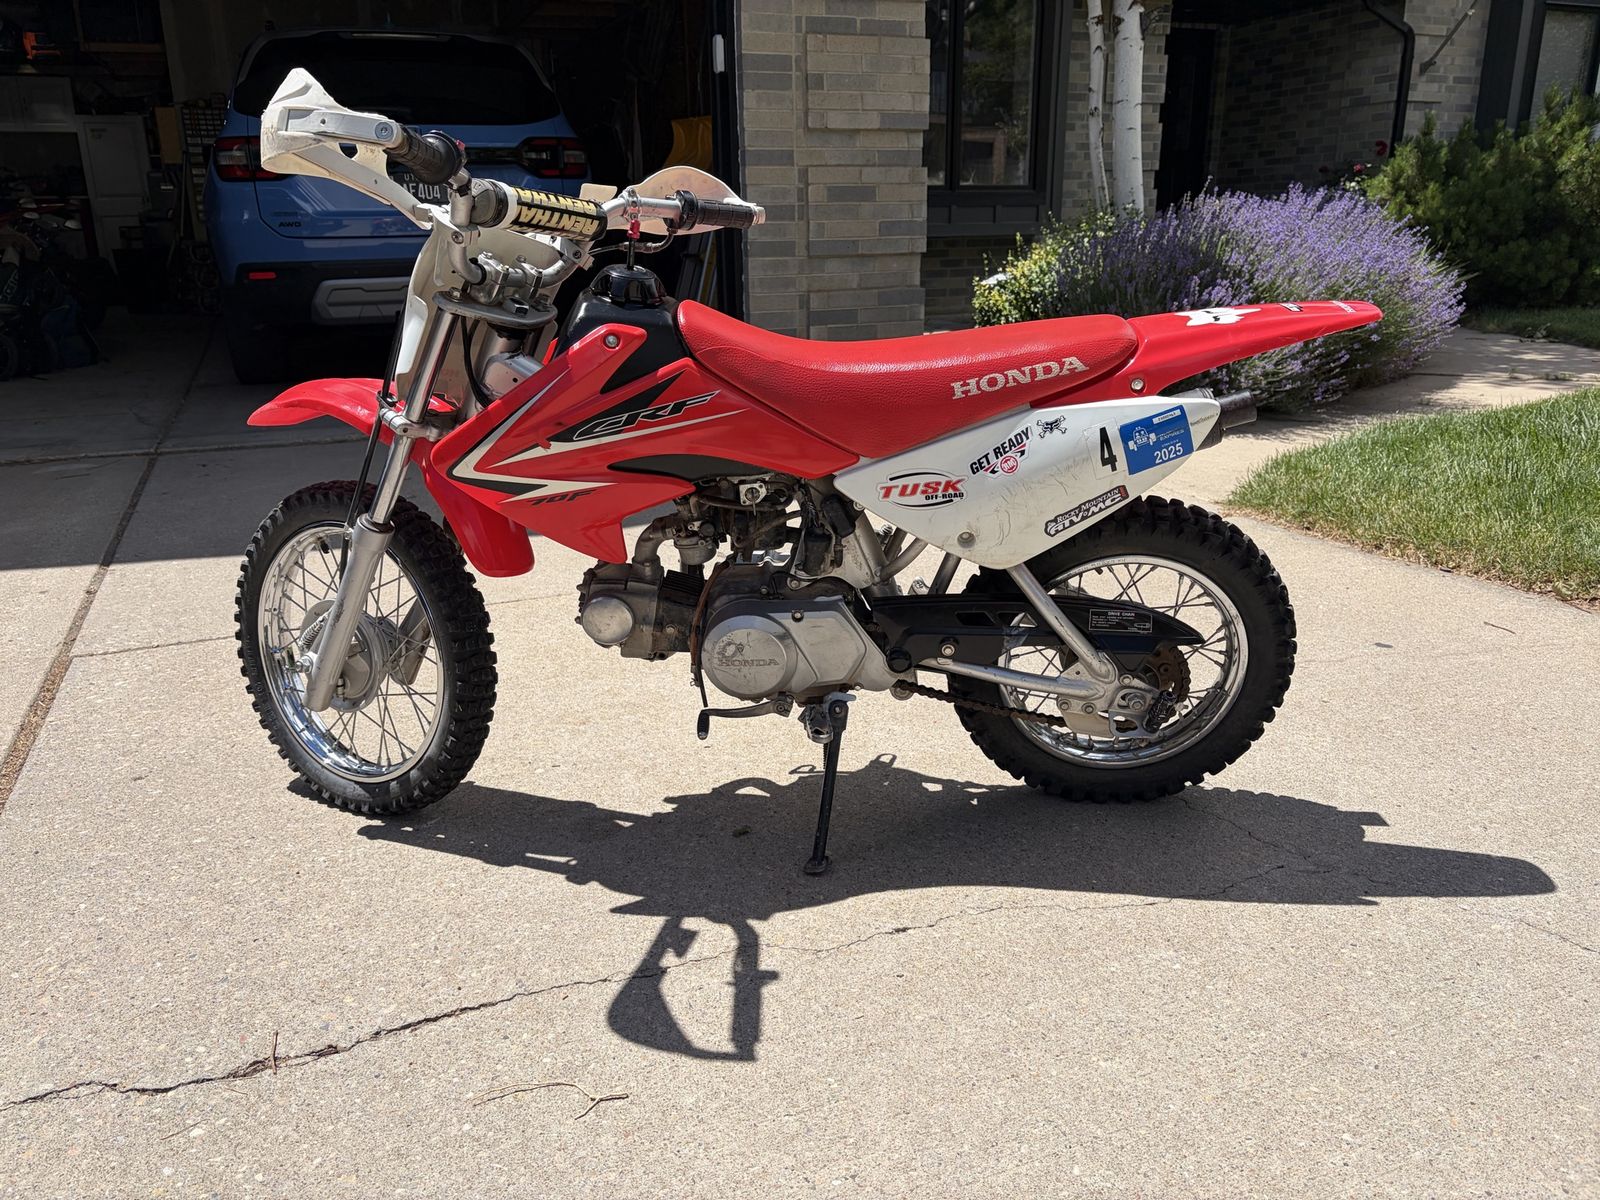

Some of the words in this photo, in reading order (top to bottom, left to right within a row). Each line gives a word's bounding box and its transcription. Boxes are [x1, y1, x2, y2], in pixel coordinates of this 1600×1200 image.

[511, 187, 598, 216] RENTHA
[513, 205, 600, 236] RENTHA
[951, 356, 1089, 400] HONDA
[573, 389, 721, 441] CRF
[970, 452, 990, 475] GET
[992, 427, 1030, 460] READY
[1099, 426, 1118, 473] 4
[1154, 443, 1184, 464] 2025
[525, 489, 597, 506] 70F
[880, 479, 965, 499] TUSK
[925, 492, 964, 500] OFF-ROAD
[1056, 507, 1080, 523] ROCKY
[1081, 488, 1119, 511] MOUNTAIN
[718, 658, 780, 667] HONDA
